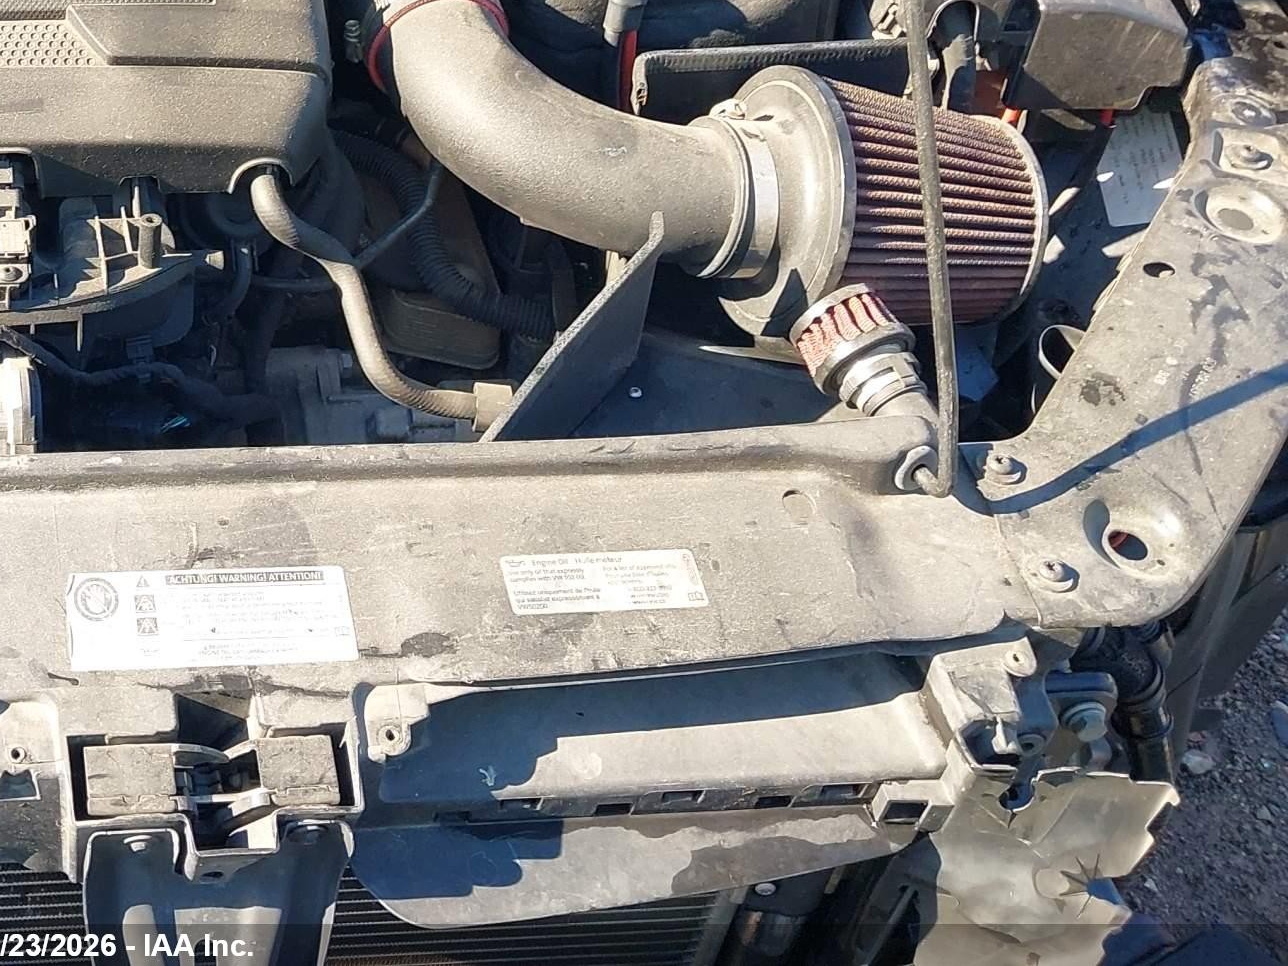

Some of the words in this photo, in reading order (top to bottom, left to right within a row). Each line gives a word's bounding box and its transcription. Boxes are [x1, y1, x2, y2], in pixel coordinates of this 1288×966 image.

[169, 573, 216, 584] ACHTUNG!
[219, 572, 266, 583] WARNING!
[268, 570, 321, 582] ATTENTION!
